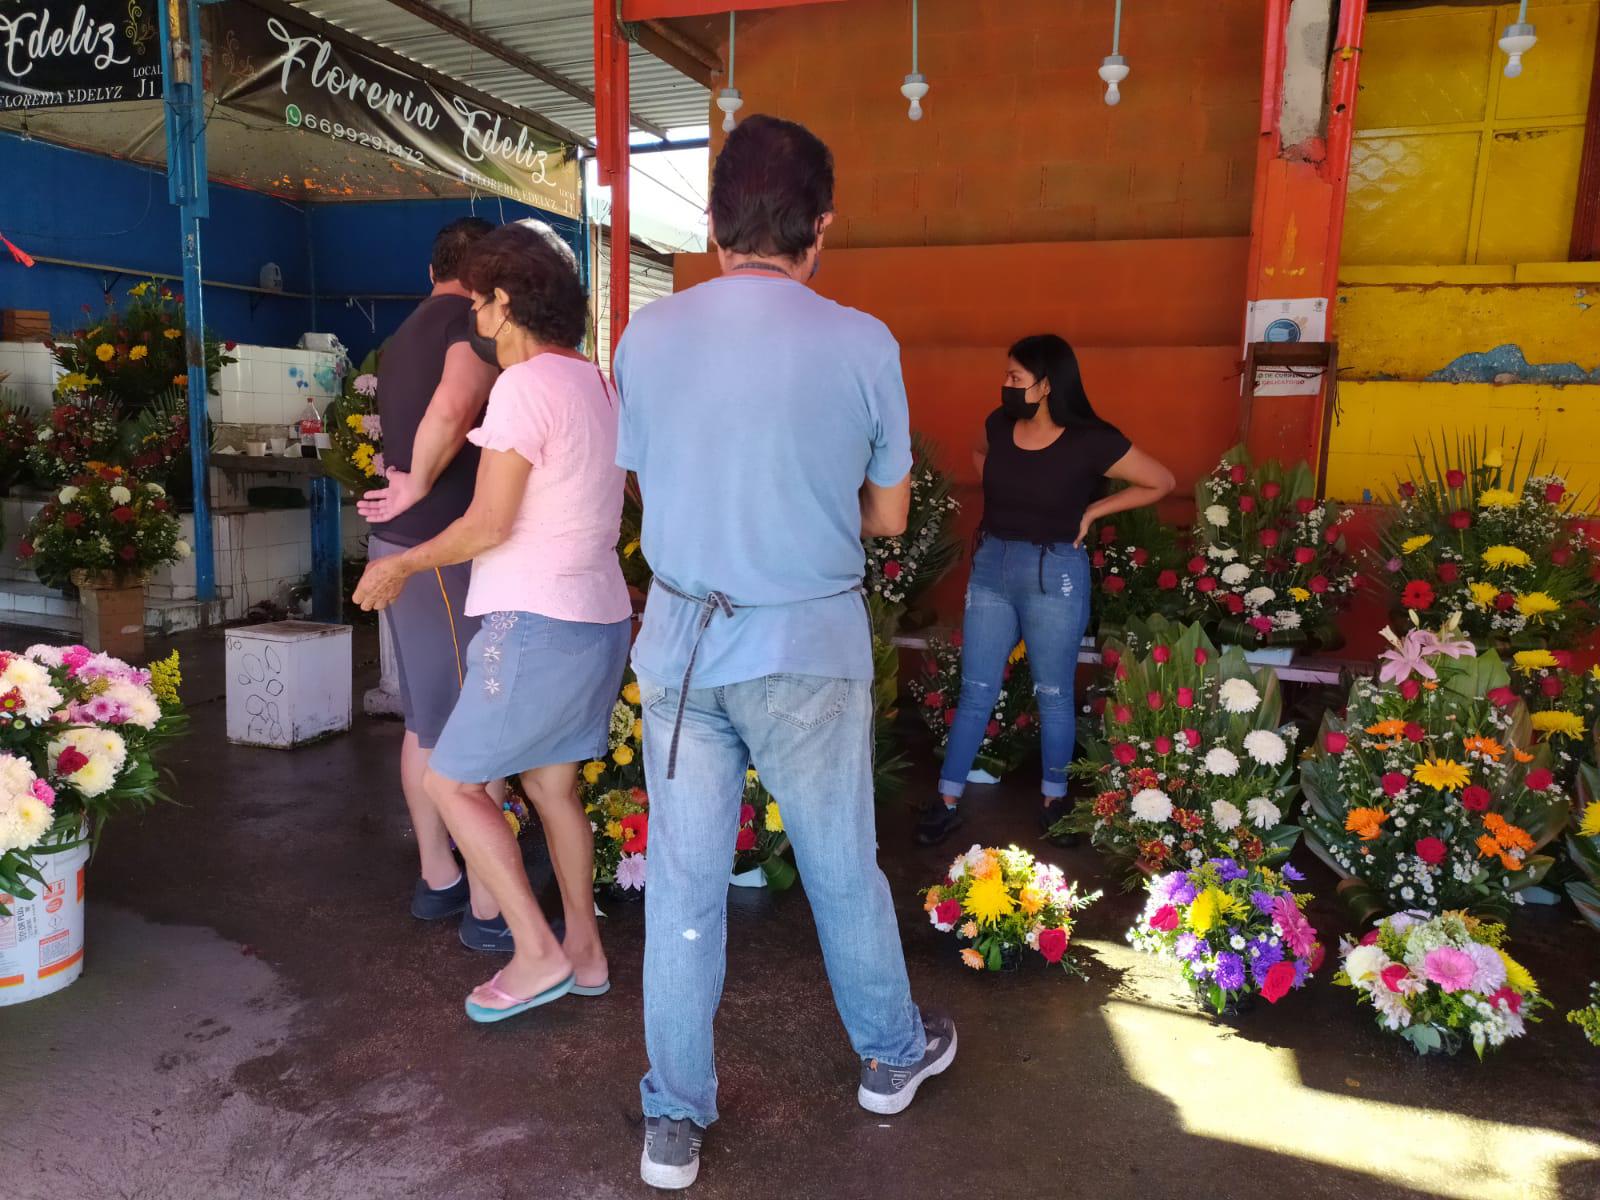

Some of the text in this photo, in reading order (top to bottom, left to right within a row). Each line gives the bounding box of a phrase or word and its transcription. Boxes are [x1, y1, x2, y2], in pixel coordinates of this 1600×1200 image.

[0, 4, 131, 77] Edeliz
[67, 85, 123, 103] EDELYZ
[133, 65, 163, 78] LOCAL
[267, 17, 556, 187] Floreria Edeliz
[305, 113, 425, 165] 6699291472
